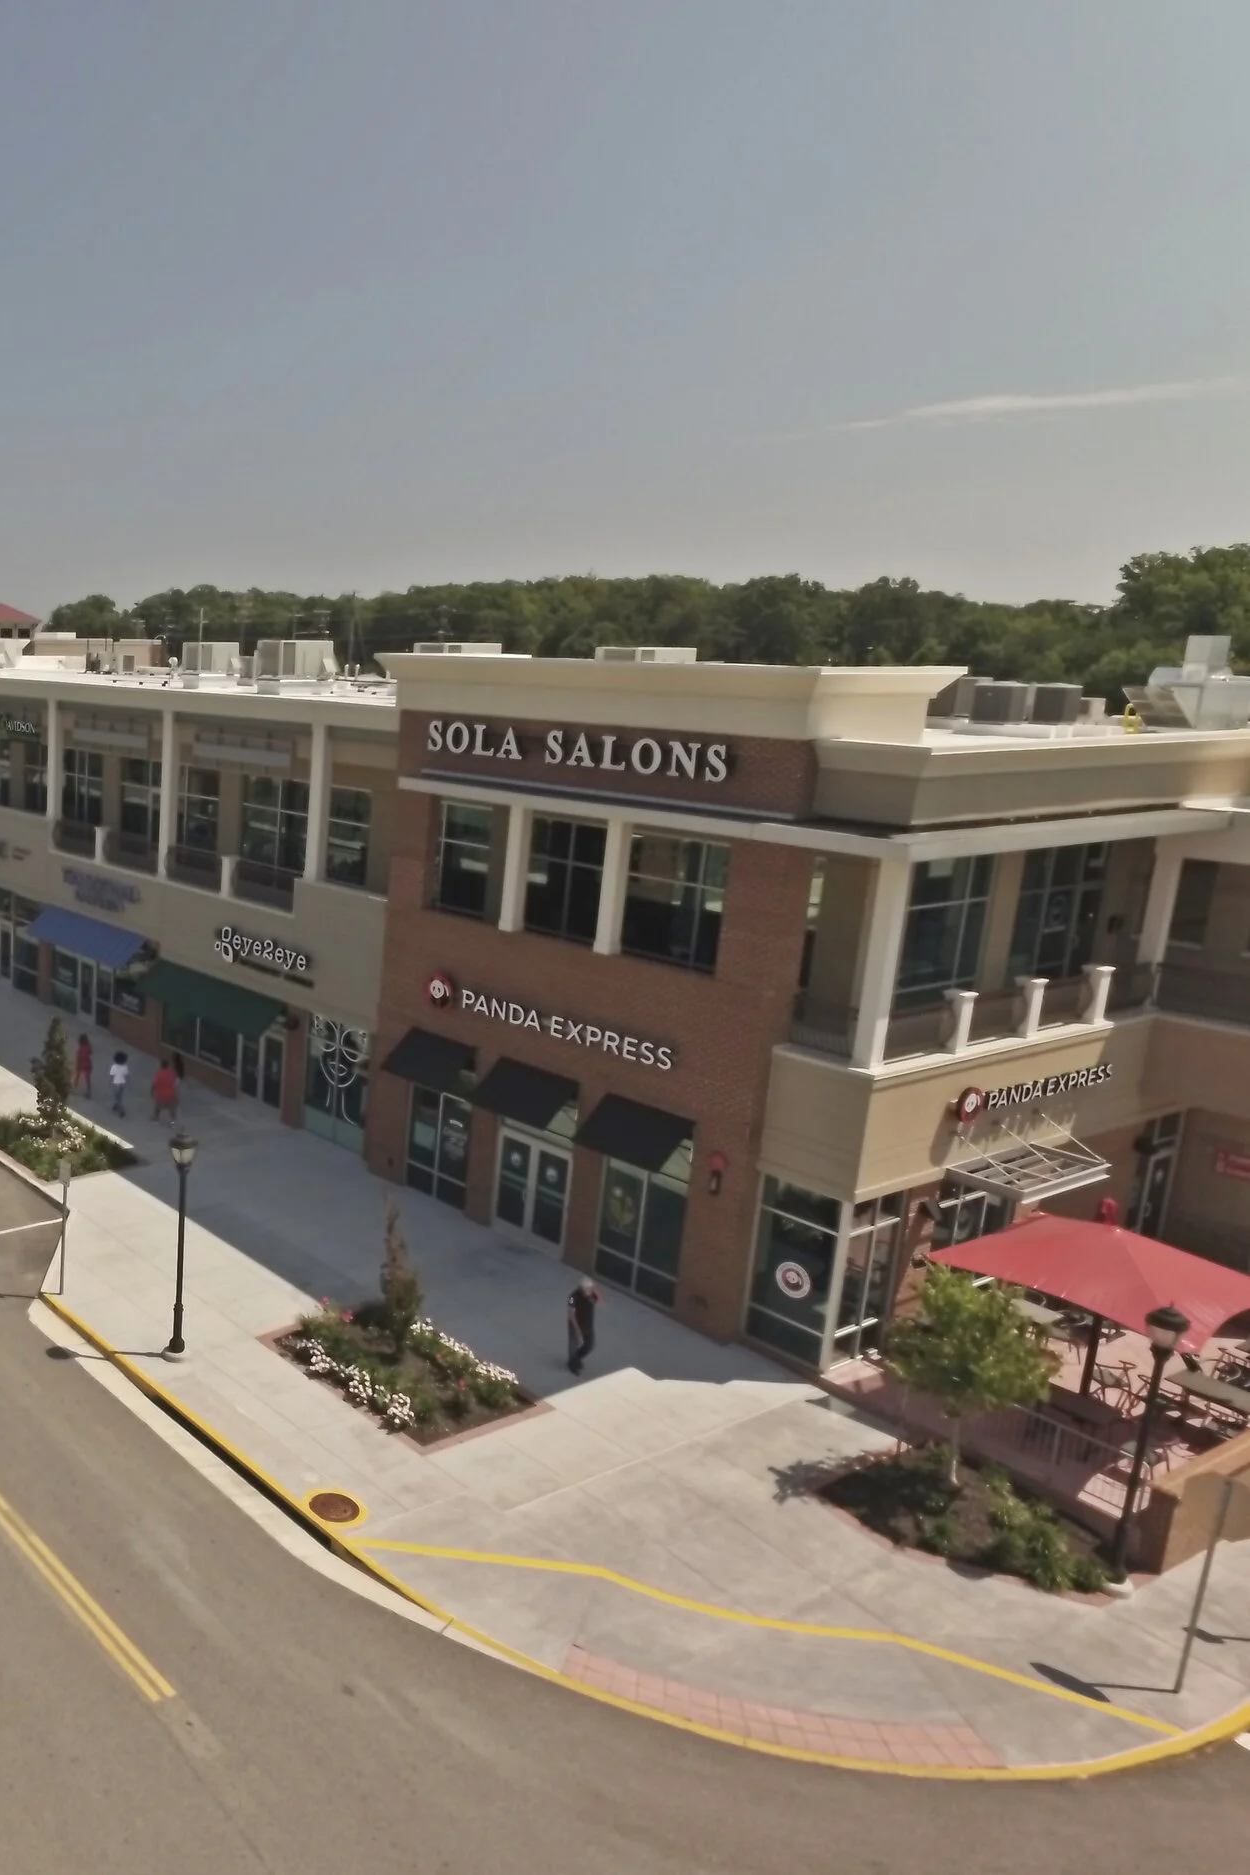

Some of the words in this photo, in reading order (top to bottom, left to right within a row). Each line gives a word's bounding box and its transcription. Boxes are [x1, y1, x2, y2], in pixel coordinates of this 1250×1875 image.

[427, 720, 522, 760] SOLA
[545, 729, 728, 782] SALONS
[232, 934, 307, 971] eye2eye
[462, 989, 541, 1032] PANDA
[550, 1015, 672, 1070] EXPRESS
[987, 1080, 1043, 1111] PANDA
[1046, 1063, 1114, 1097] EXPRESS
